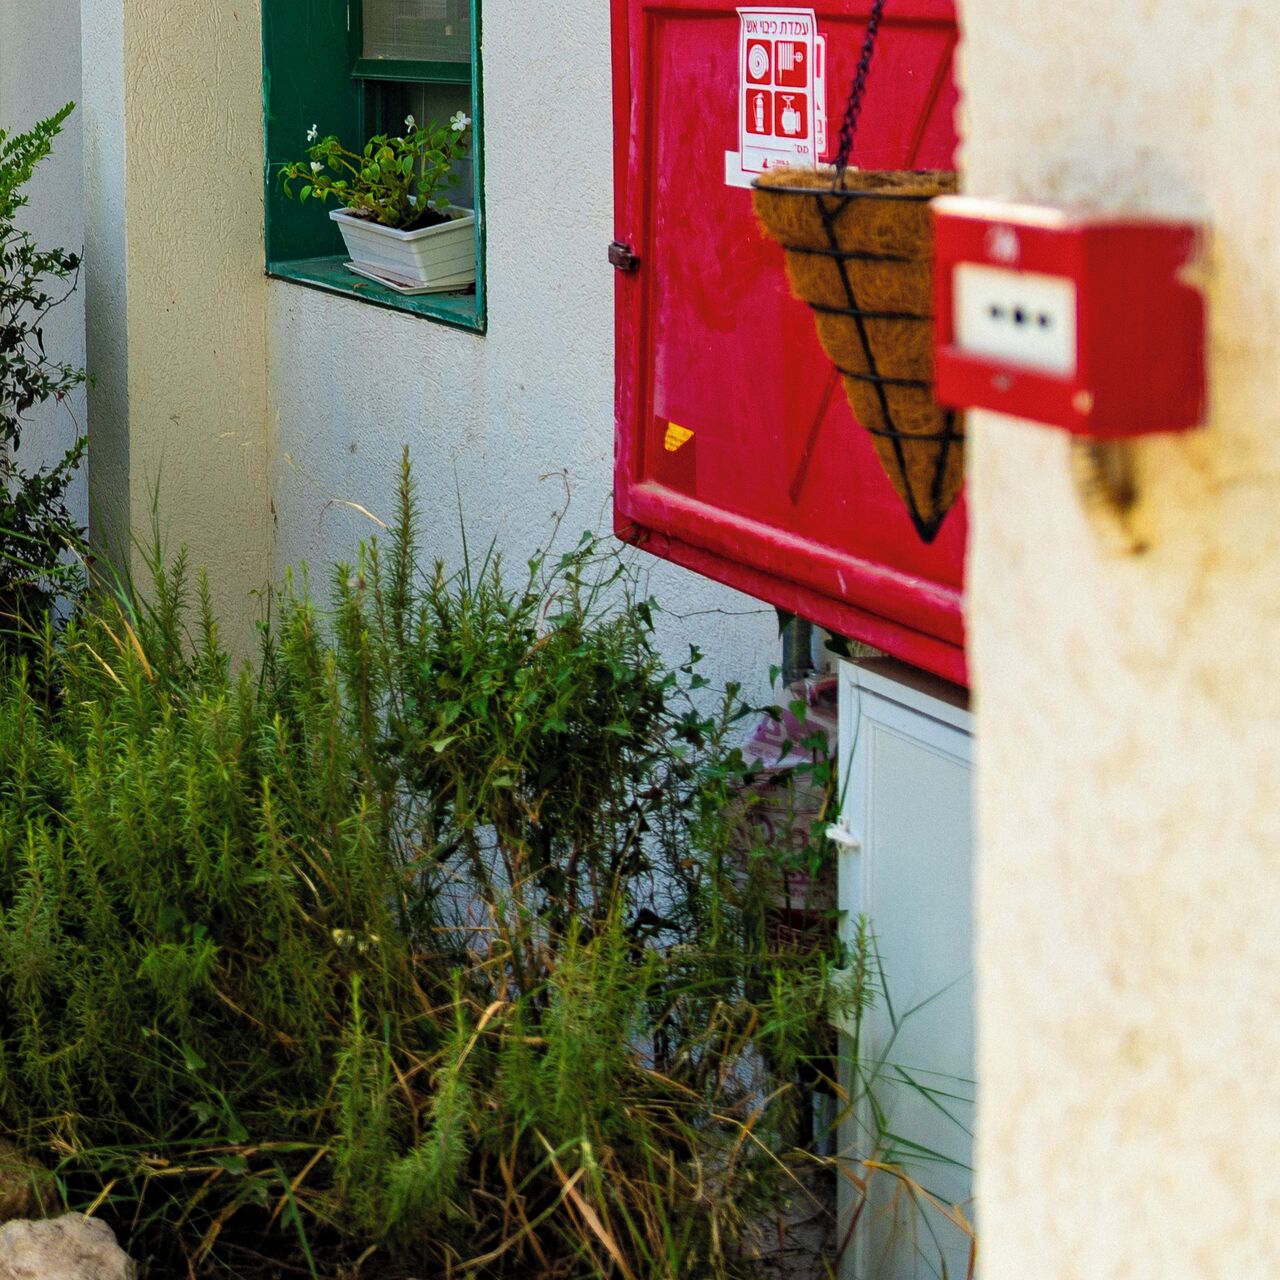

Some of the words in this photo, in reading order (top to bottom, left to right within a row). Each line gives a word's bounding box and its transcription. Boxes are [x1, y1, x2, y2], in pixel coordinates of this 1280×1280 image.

[746, 19, 758, 33] אש
[760, 20, 778, 35] כיבוי
[780, 21, 809, 35] עמדת
